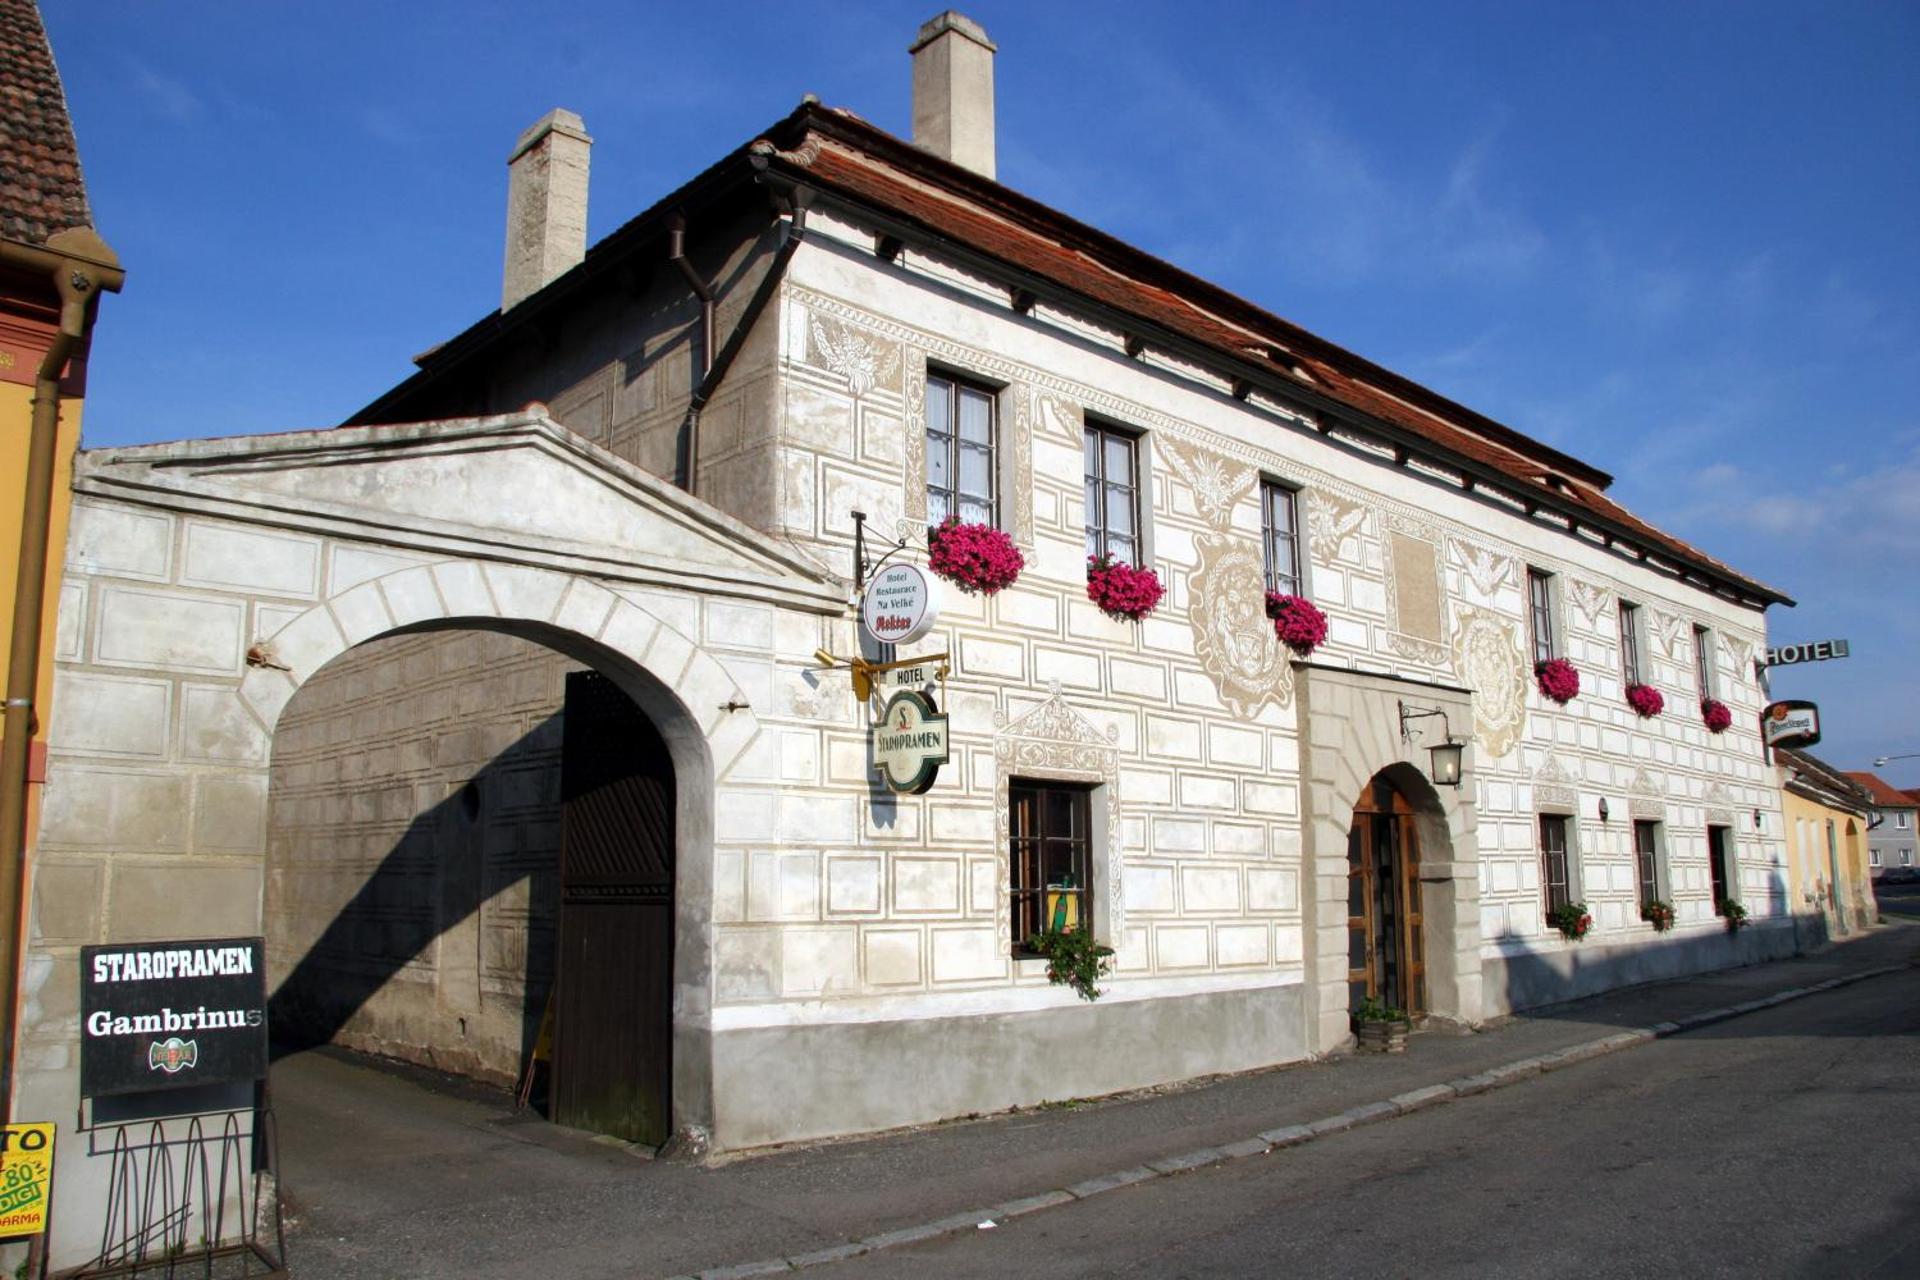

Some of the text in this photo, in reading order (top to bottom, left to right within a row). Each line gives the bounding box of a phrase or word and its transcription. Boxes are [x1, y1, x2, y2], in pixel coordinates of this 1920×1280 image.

[1765, 639, 1847, 665] HOTEL
[896, 668, 924, 685] HOTEL
[93, 947, 253, 983] STAROPRAMEN
[87, 1006, 264, 1037] Gambrinus
